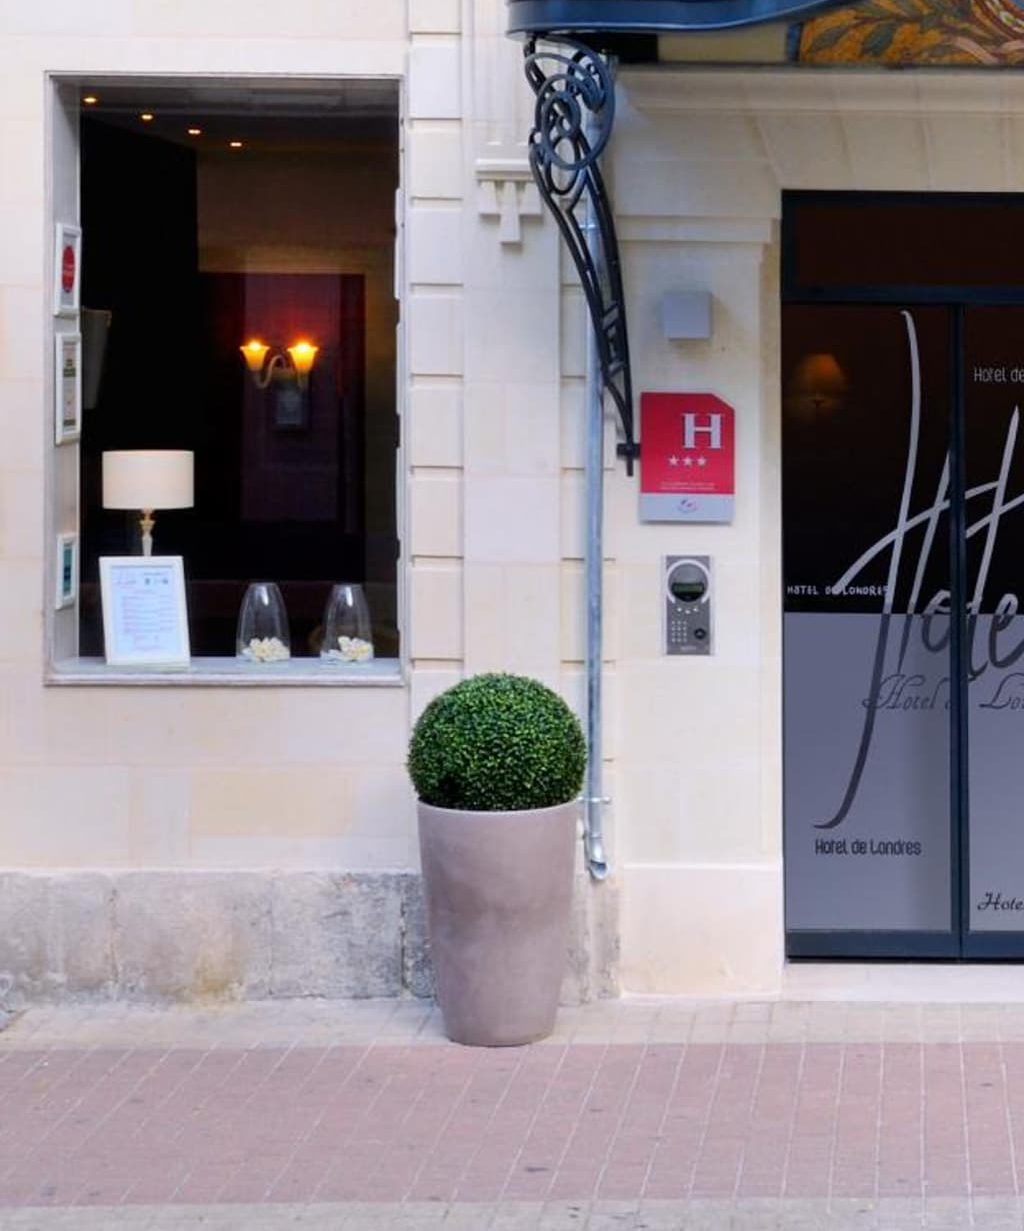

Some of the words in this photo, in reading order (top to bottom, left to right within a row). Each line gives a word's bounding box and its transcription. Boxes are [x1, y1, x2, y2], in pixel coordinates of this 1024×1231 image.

[974, 366, 1007, 383] Hotel
[683, 413, 723, 449] H
[825, 585, 839, 596] D
[815, 838, 848, 855] Hotel
[851, 838, 867, 855] de
[870, 838, 922, 856] Londres
